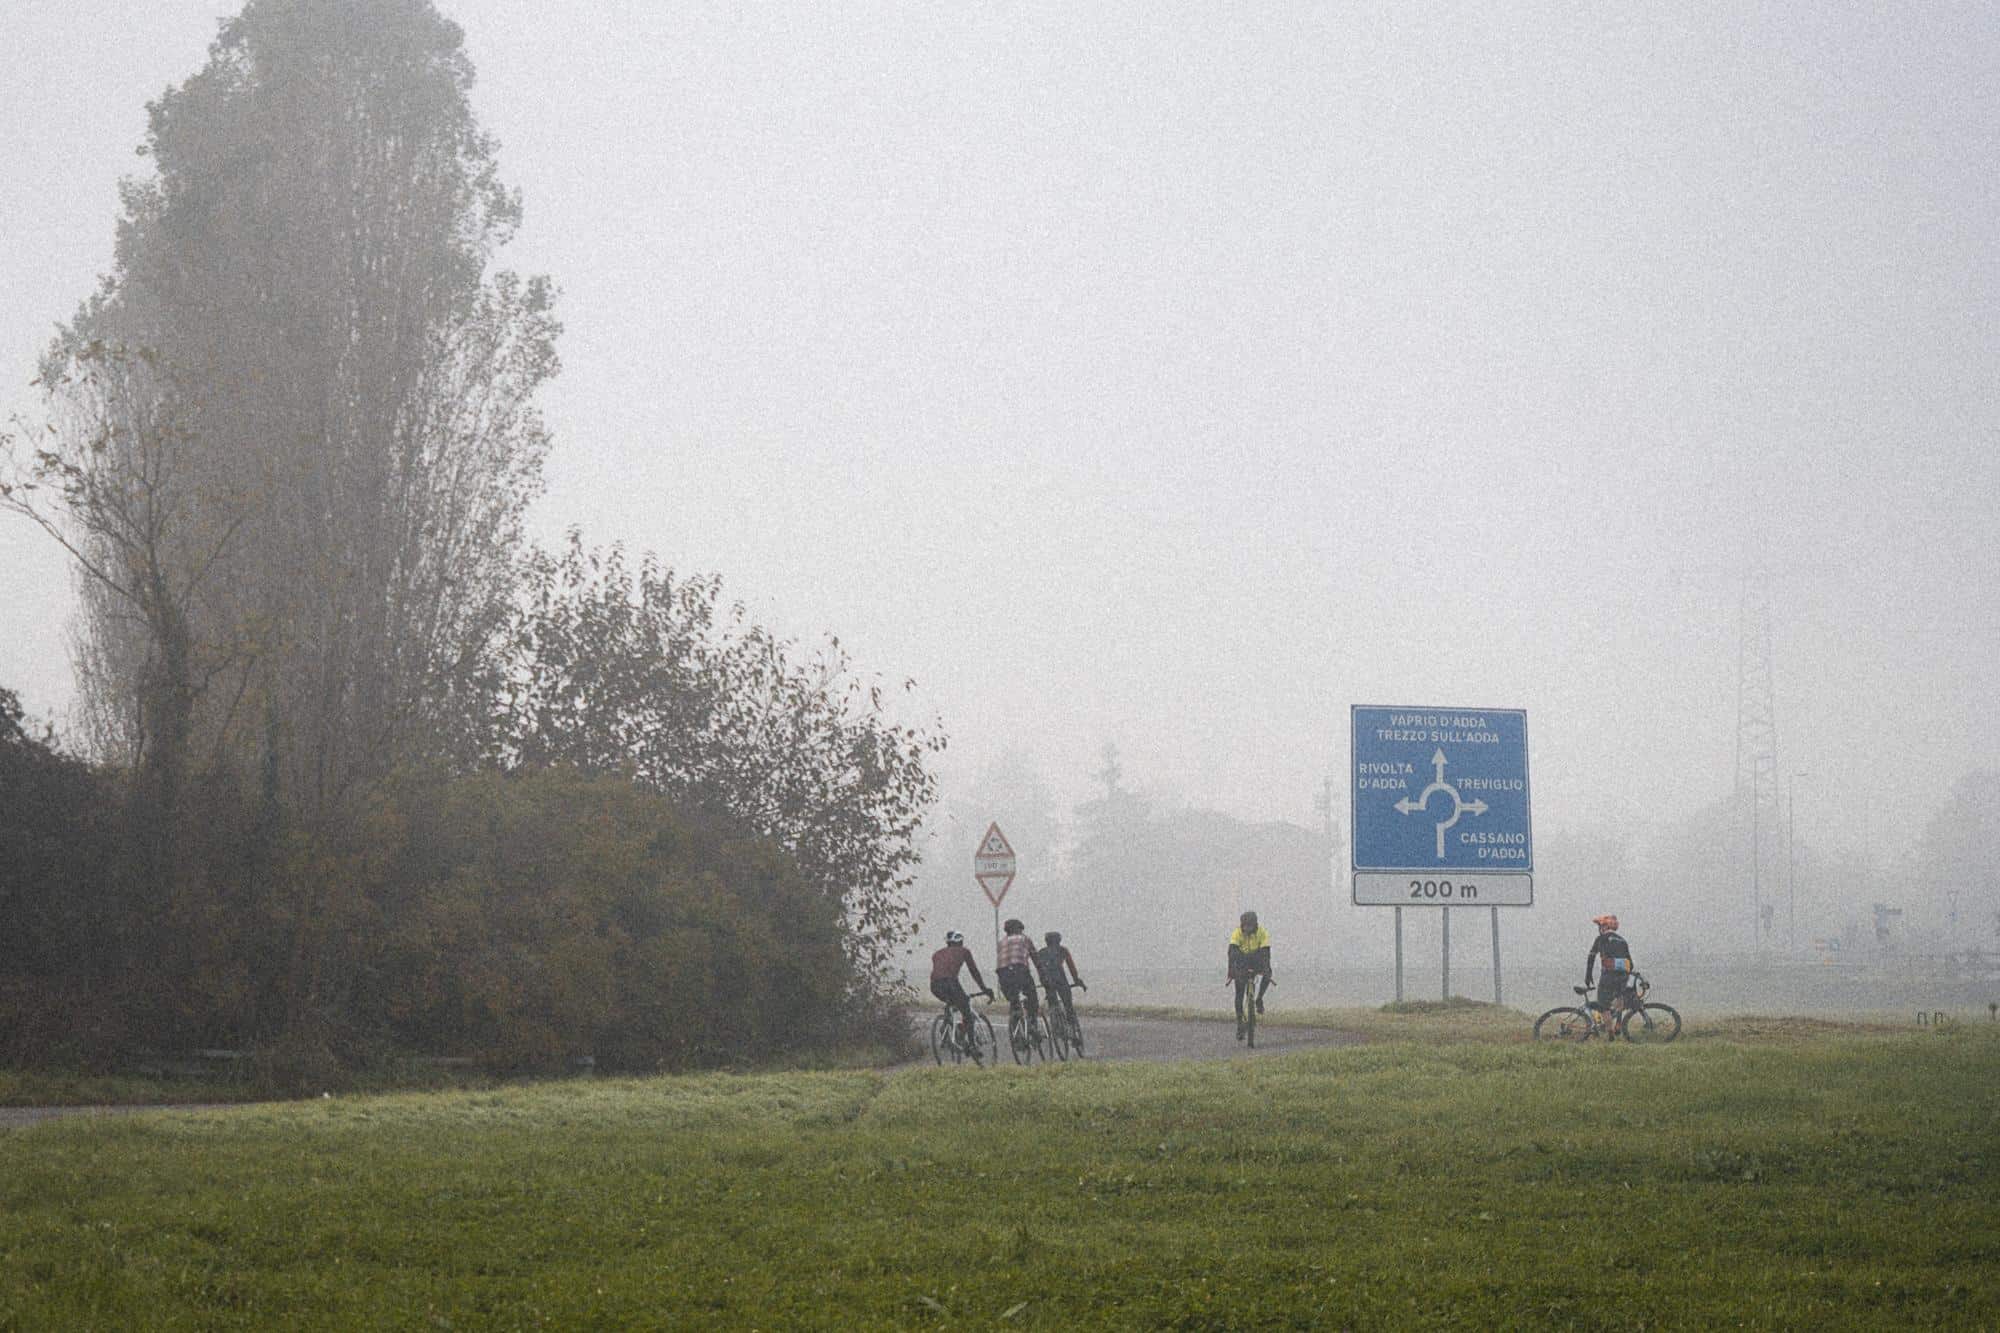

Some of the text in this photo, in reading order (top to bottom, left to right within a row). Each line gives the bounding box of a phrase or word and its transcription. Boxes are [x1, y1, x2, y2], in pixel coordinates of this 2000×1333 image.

[1440, 717, 1487, 729] D'ADDA
[1377, 730, 1499, 743] TREZZO SULL'ADDA
[1359, 763, 1414, 774] RIVOLTA
[1359, 779, 1407, 789] D'ADDA
[1457, 779, 1523, 790] TREVIGLIO
[1461, 833, 1525, 844] CASSANO
[1478, 848, 1526, 859] D'ADDA
[1410, 881, 1478, 898] 200 m
